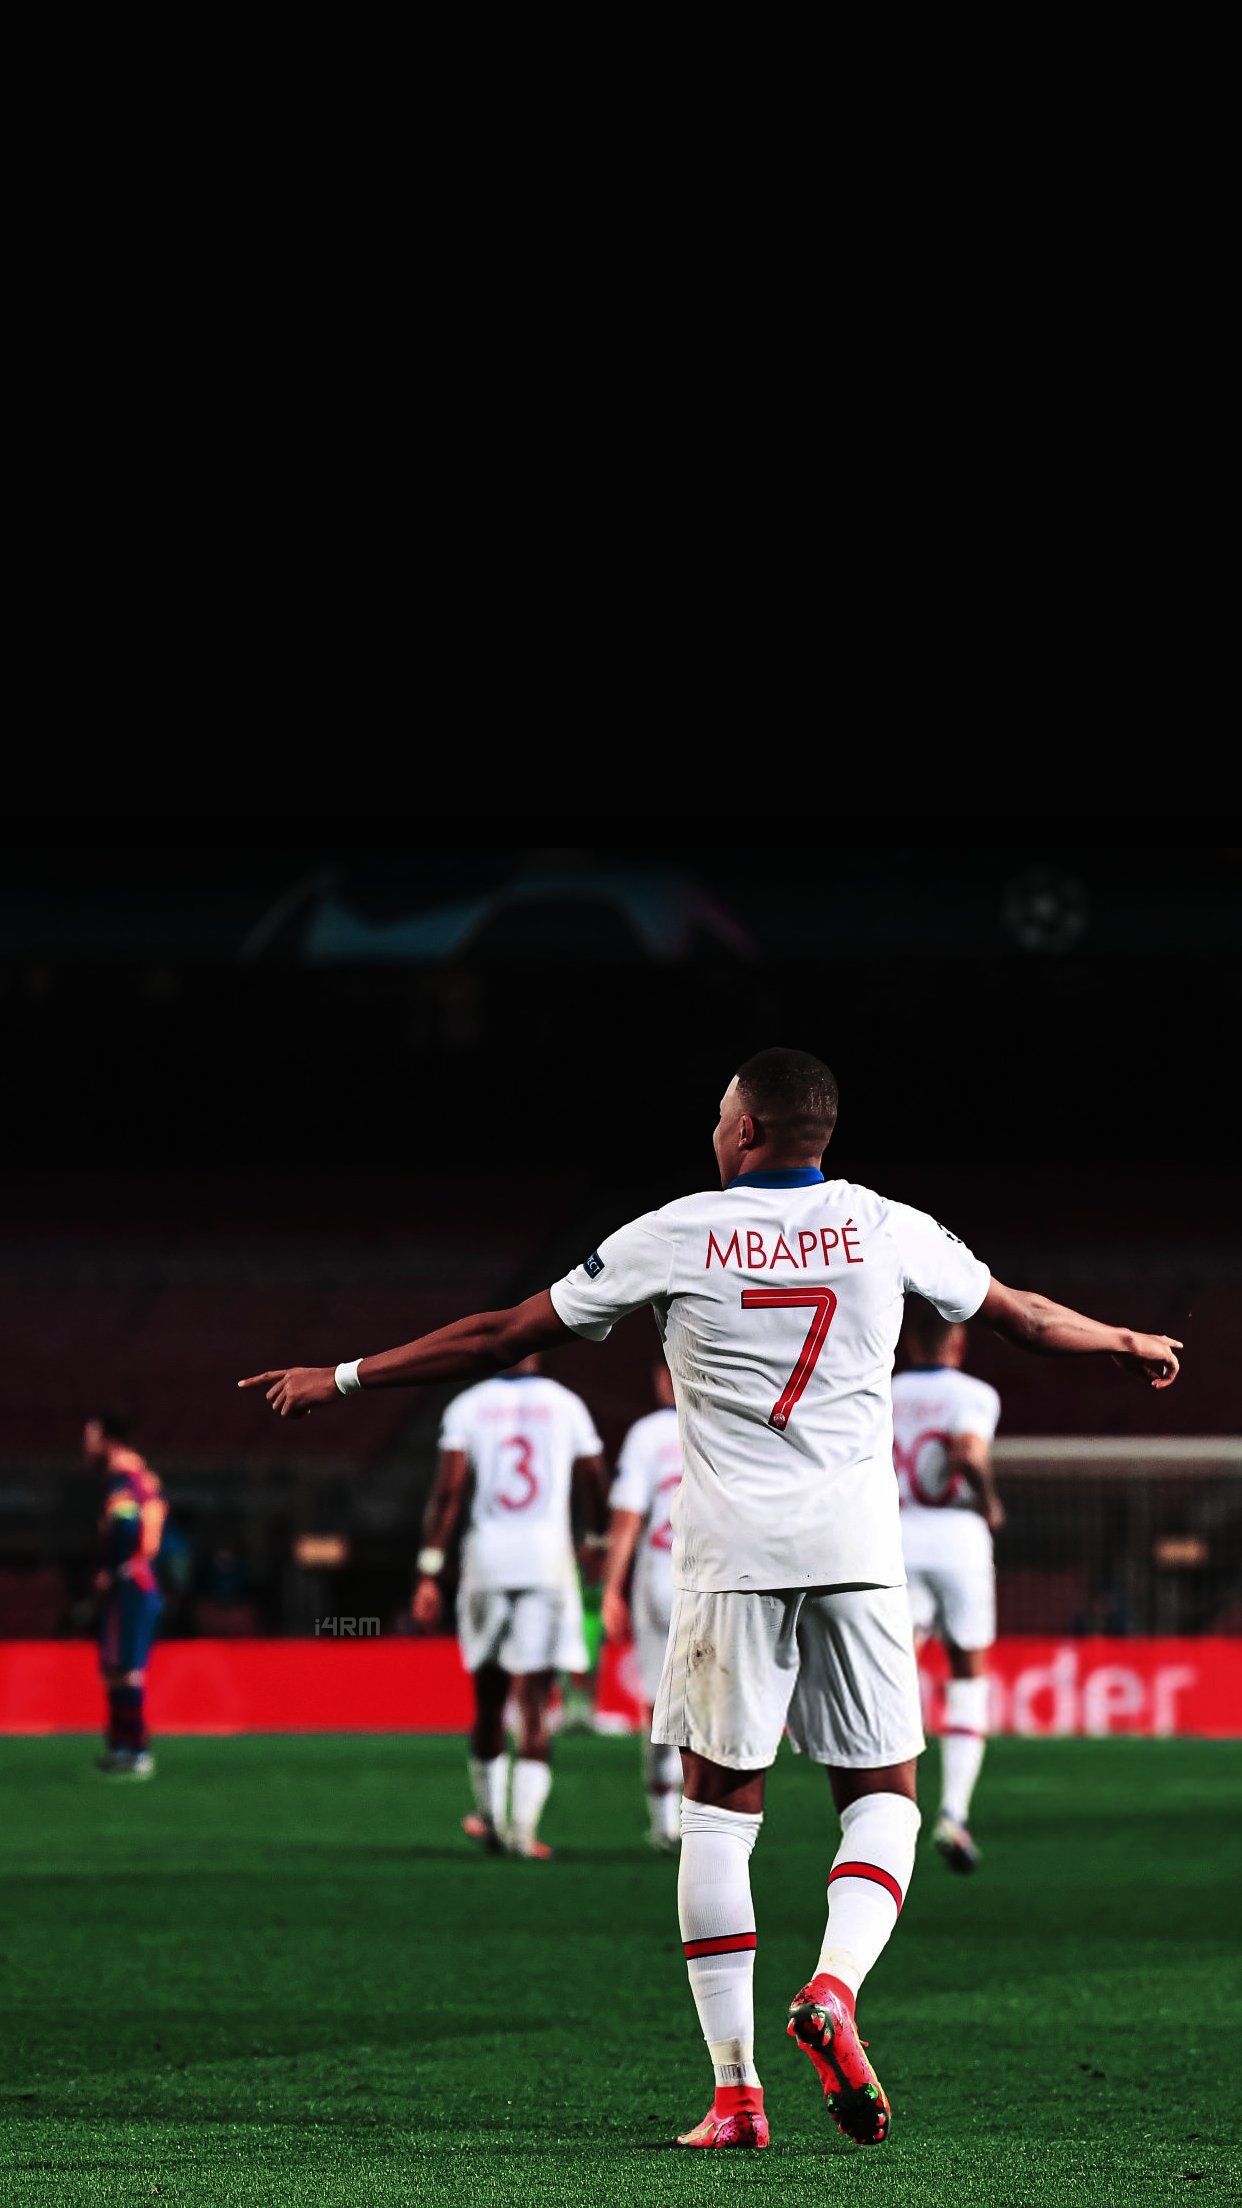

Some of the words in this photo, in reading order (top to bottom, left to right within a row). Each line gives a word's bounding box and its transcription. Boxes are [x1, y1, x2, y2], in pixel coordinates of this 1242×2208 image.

[705, 1218, 865, 1270] MBAPPÉ
[740, 1286, 838, 1432] 7
[497, 1434, 539, 1512] 3
